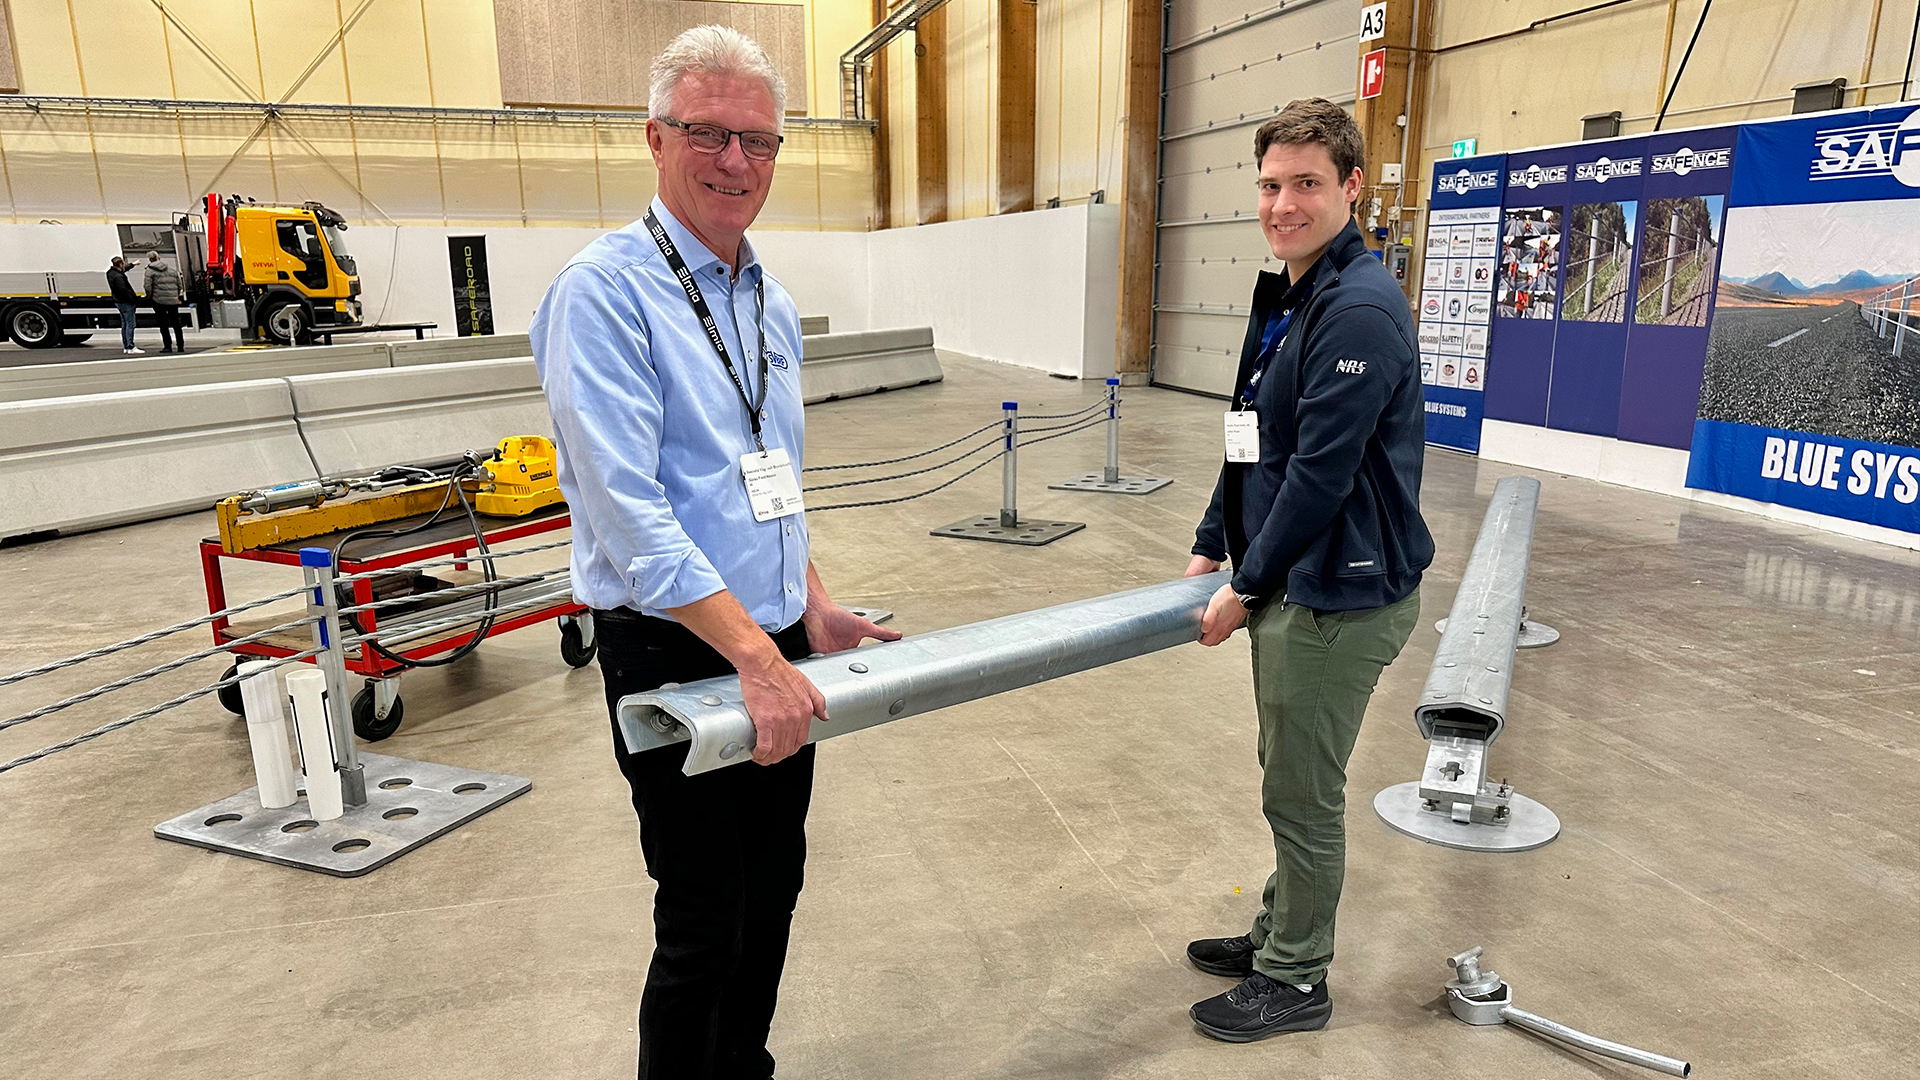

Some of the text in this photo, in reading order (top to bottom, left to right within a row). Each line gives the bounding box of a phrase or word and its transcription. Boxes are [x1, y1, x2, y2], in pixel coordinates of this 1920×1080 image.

[1361, 8, 1384, 38] A3
[1575, 159, 1642, 179] SAFENCE
[1651, 151, 1731, 171] SAFENCE
[1438, 172, 1498, 190] SAFENCE
[1508, 167, 1568, 185] SAFENCE
[1438, 211, 1491, 221] INTERNATIONAL PARTNERS
[652, 224, 674, 256] Elmia
[464, 245, 480, 331] SAFEROAD
[676, 266, 701, 303] Elmia
[702, 315, 724, 352] Elmia
[1335, 359, 1367, 375] NRS
[1424, 401, 1467, 418] BLUE SYSTEMS
[1761, 437, 1844, 490] BLUE
